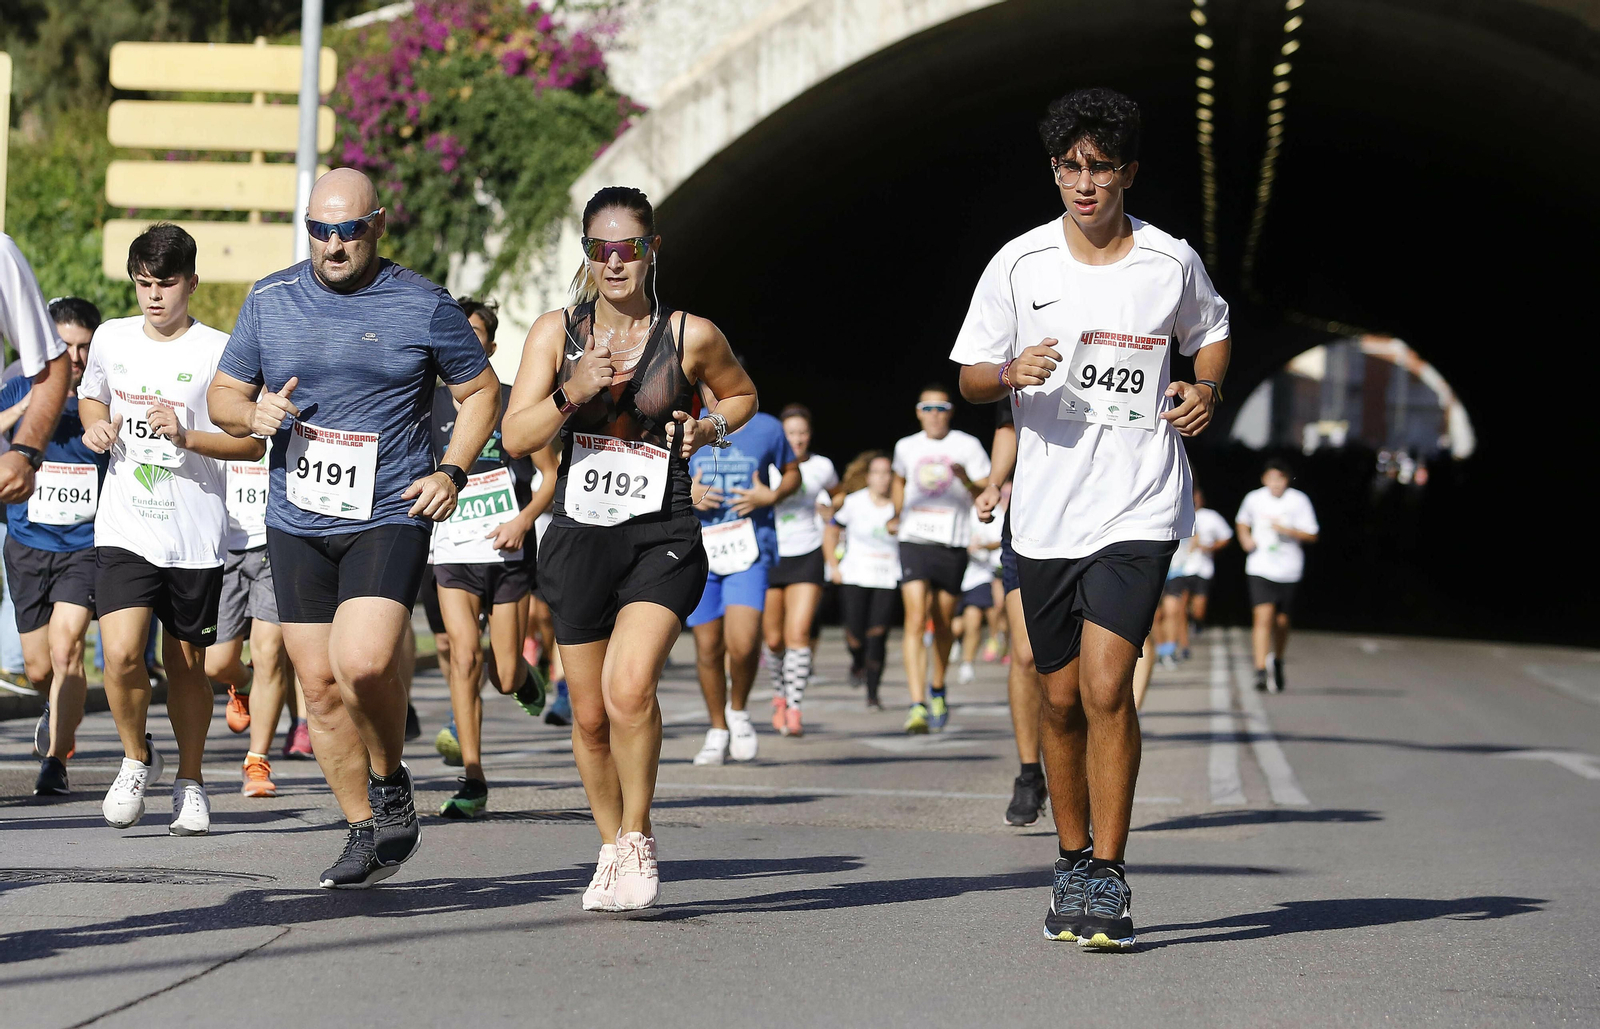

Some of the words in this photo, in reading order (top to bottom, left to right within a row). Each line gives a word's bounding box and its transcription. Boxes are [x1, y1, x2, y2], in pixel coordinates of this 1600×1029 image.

[1081, 332, 1094, 345] 41
[1094, 332, 1133, 342] CARRERA
[1135, 336, 1167, 346] URBANA
[1080, 364, 1145, 394] 9429
[304, 426, 341, 440] CARRERA
[342, 433, 377, 442] URBANA
[575, 435, 592, 449] 41
[593, 437, 632, 448] CARRERA
[634, 442, 667, 459] URBANA
[296, 456, 356, 488] 9191
[35, 485, 91, 504] 17694
[583, 469, 648, 499] 9192
[132, 495, 175, 507] Fundación
[450, 493, 510, 522] 24011
[138, 510, 169, 521] Unicaja
